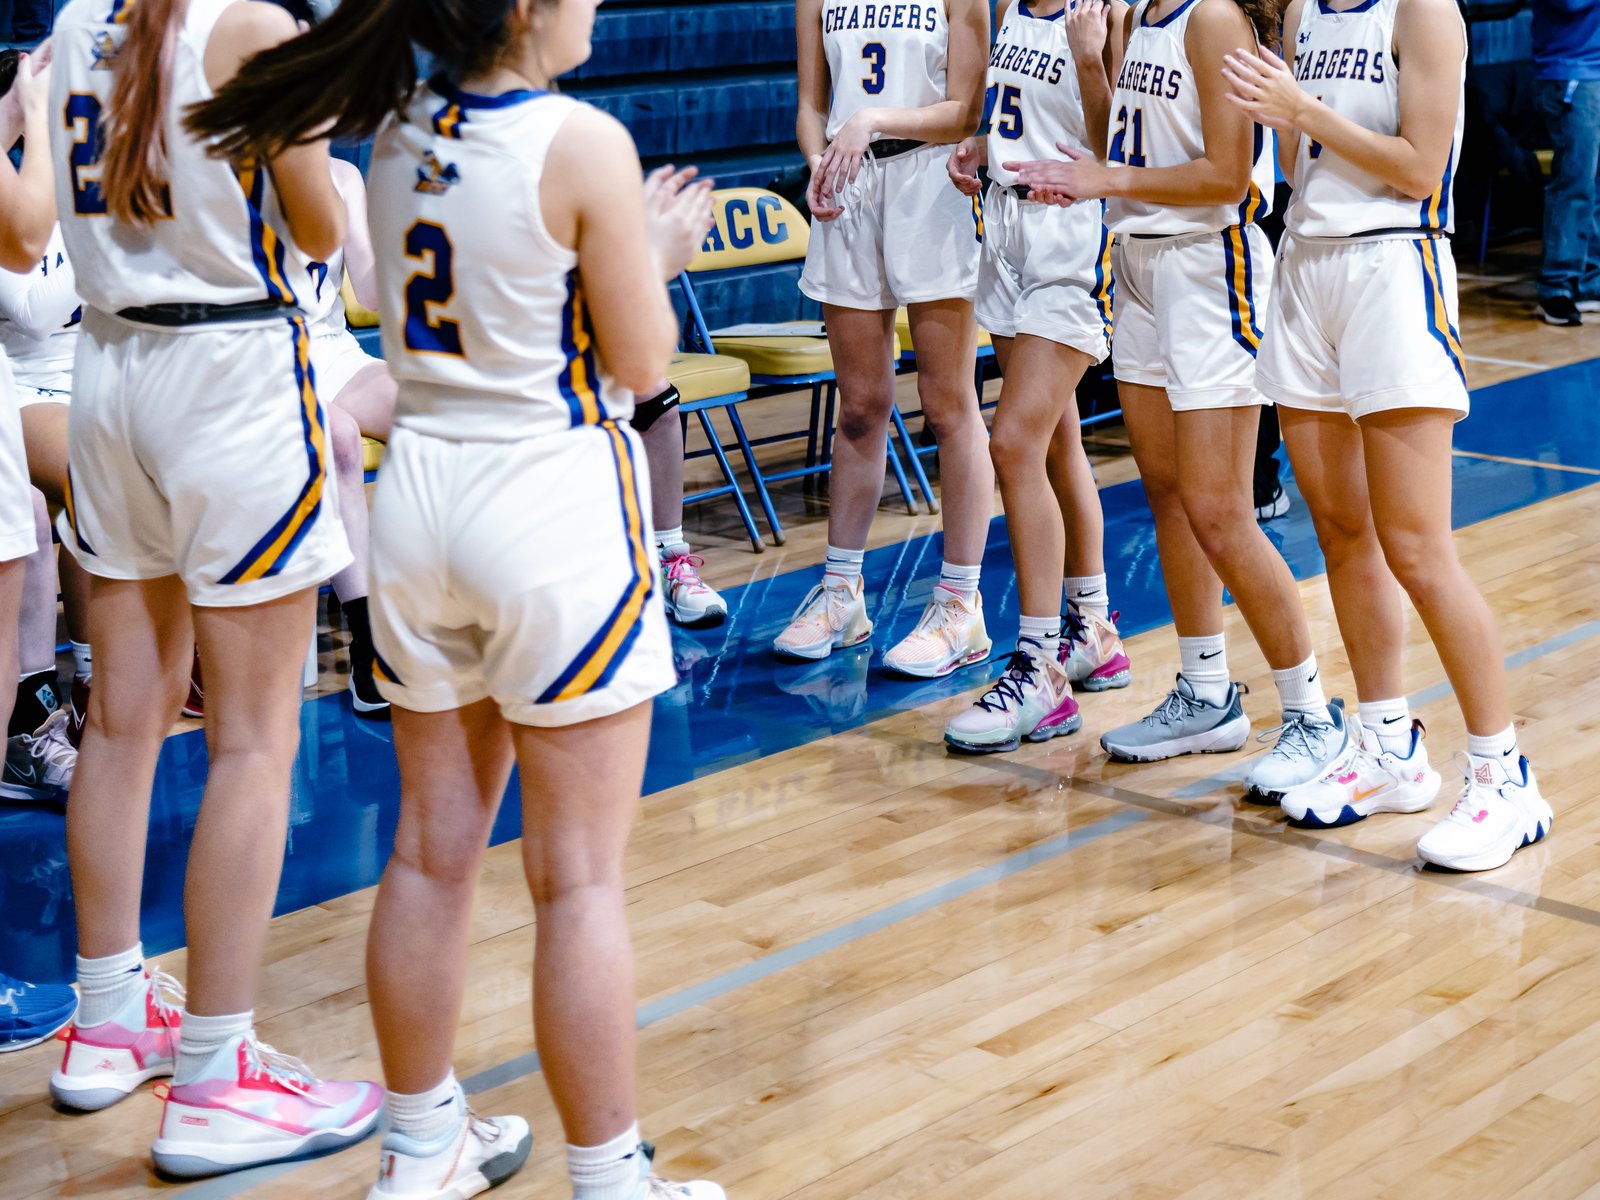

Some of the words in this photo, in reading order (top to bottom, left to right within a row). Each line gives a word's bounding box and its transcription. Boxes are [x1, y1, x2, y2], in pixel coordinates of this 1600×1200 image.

[825, 4, 937, 34] CHARGERS
[861, 41, 887, 95] 3
[1107, 104, 1147, 168] 21
[404, 217, 467, 360] 2
